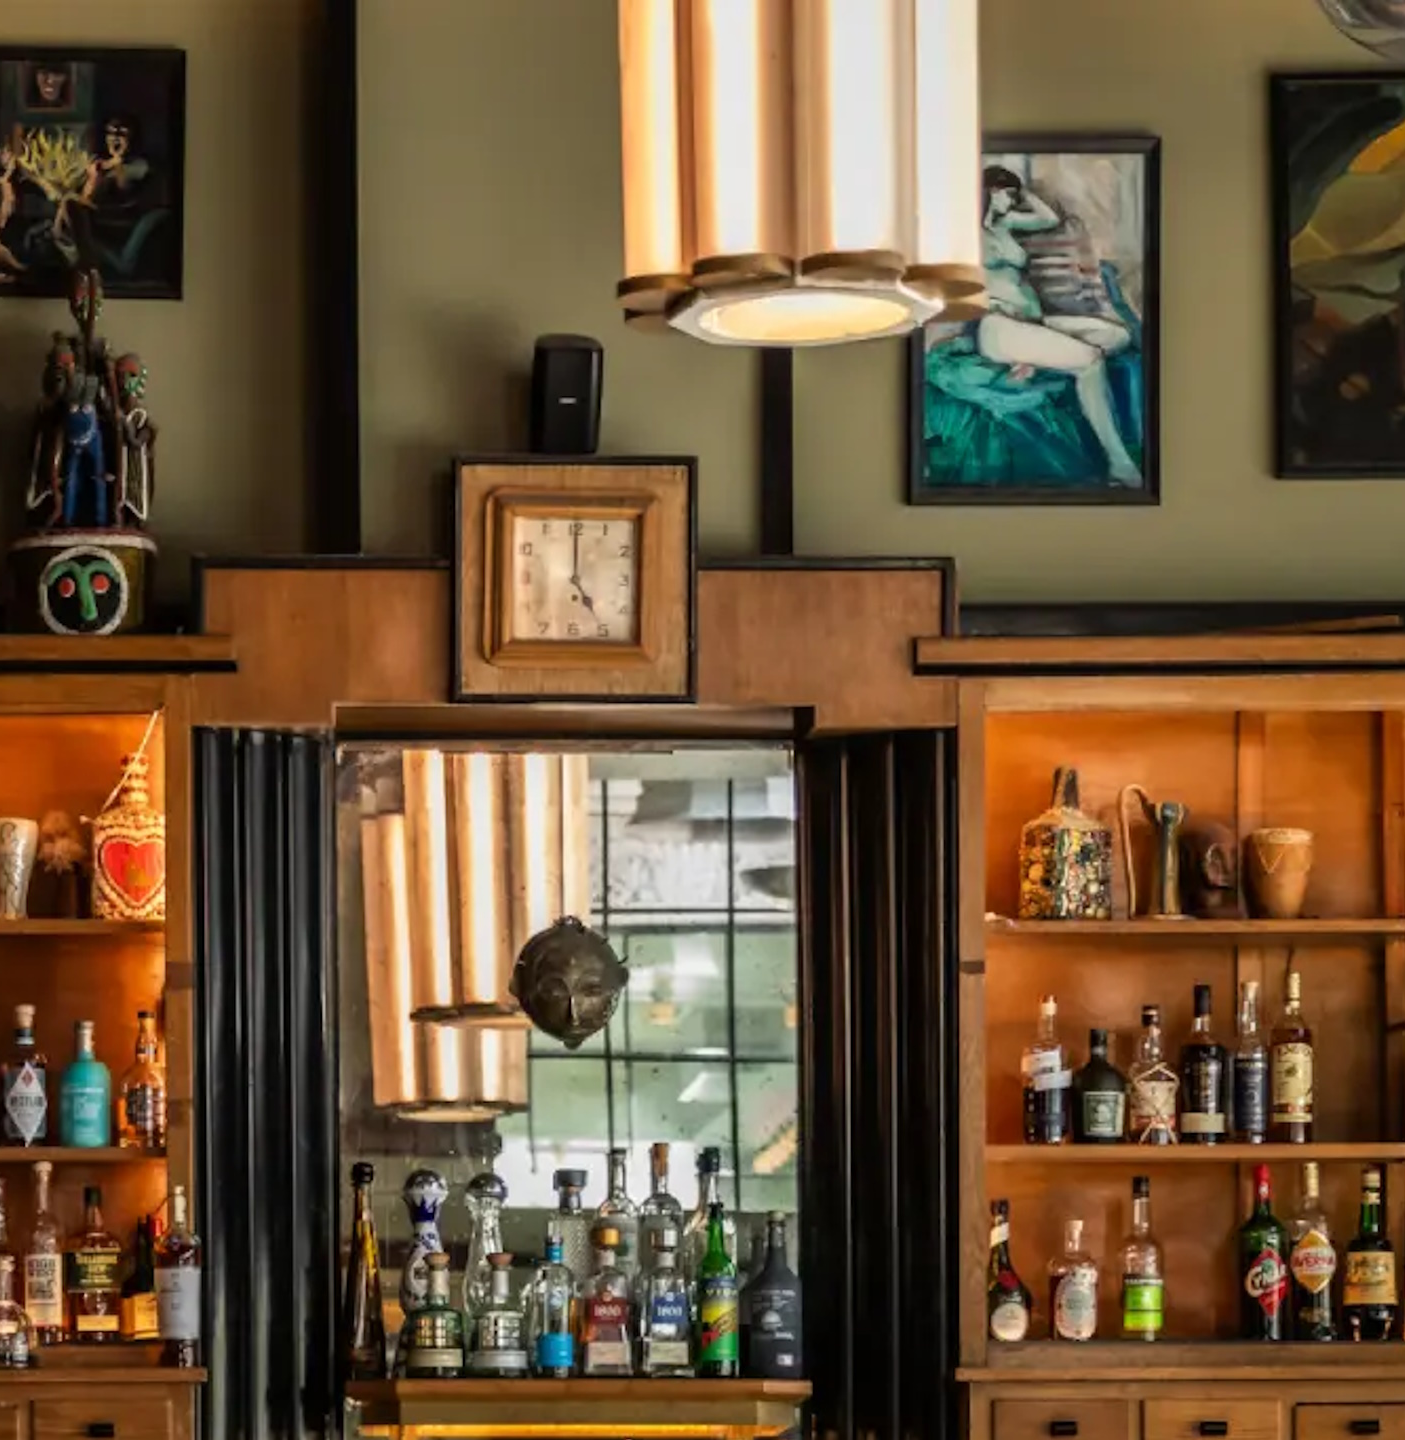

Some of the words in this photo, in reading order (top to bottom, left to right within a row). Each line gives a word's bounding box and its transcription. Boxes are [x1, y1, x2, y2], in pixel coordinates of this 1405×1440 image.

[568, 522, 583, 536] 12
[619, 545, 631, 557] 2
[619, 573, 630, 587] 3
[537, 622, 550, 634] 7
[567, 621, 580, 635] 6
[597, 623, 609, 637] 5
